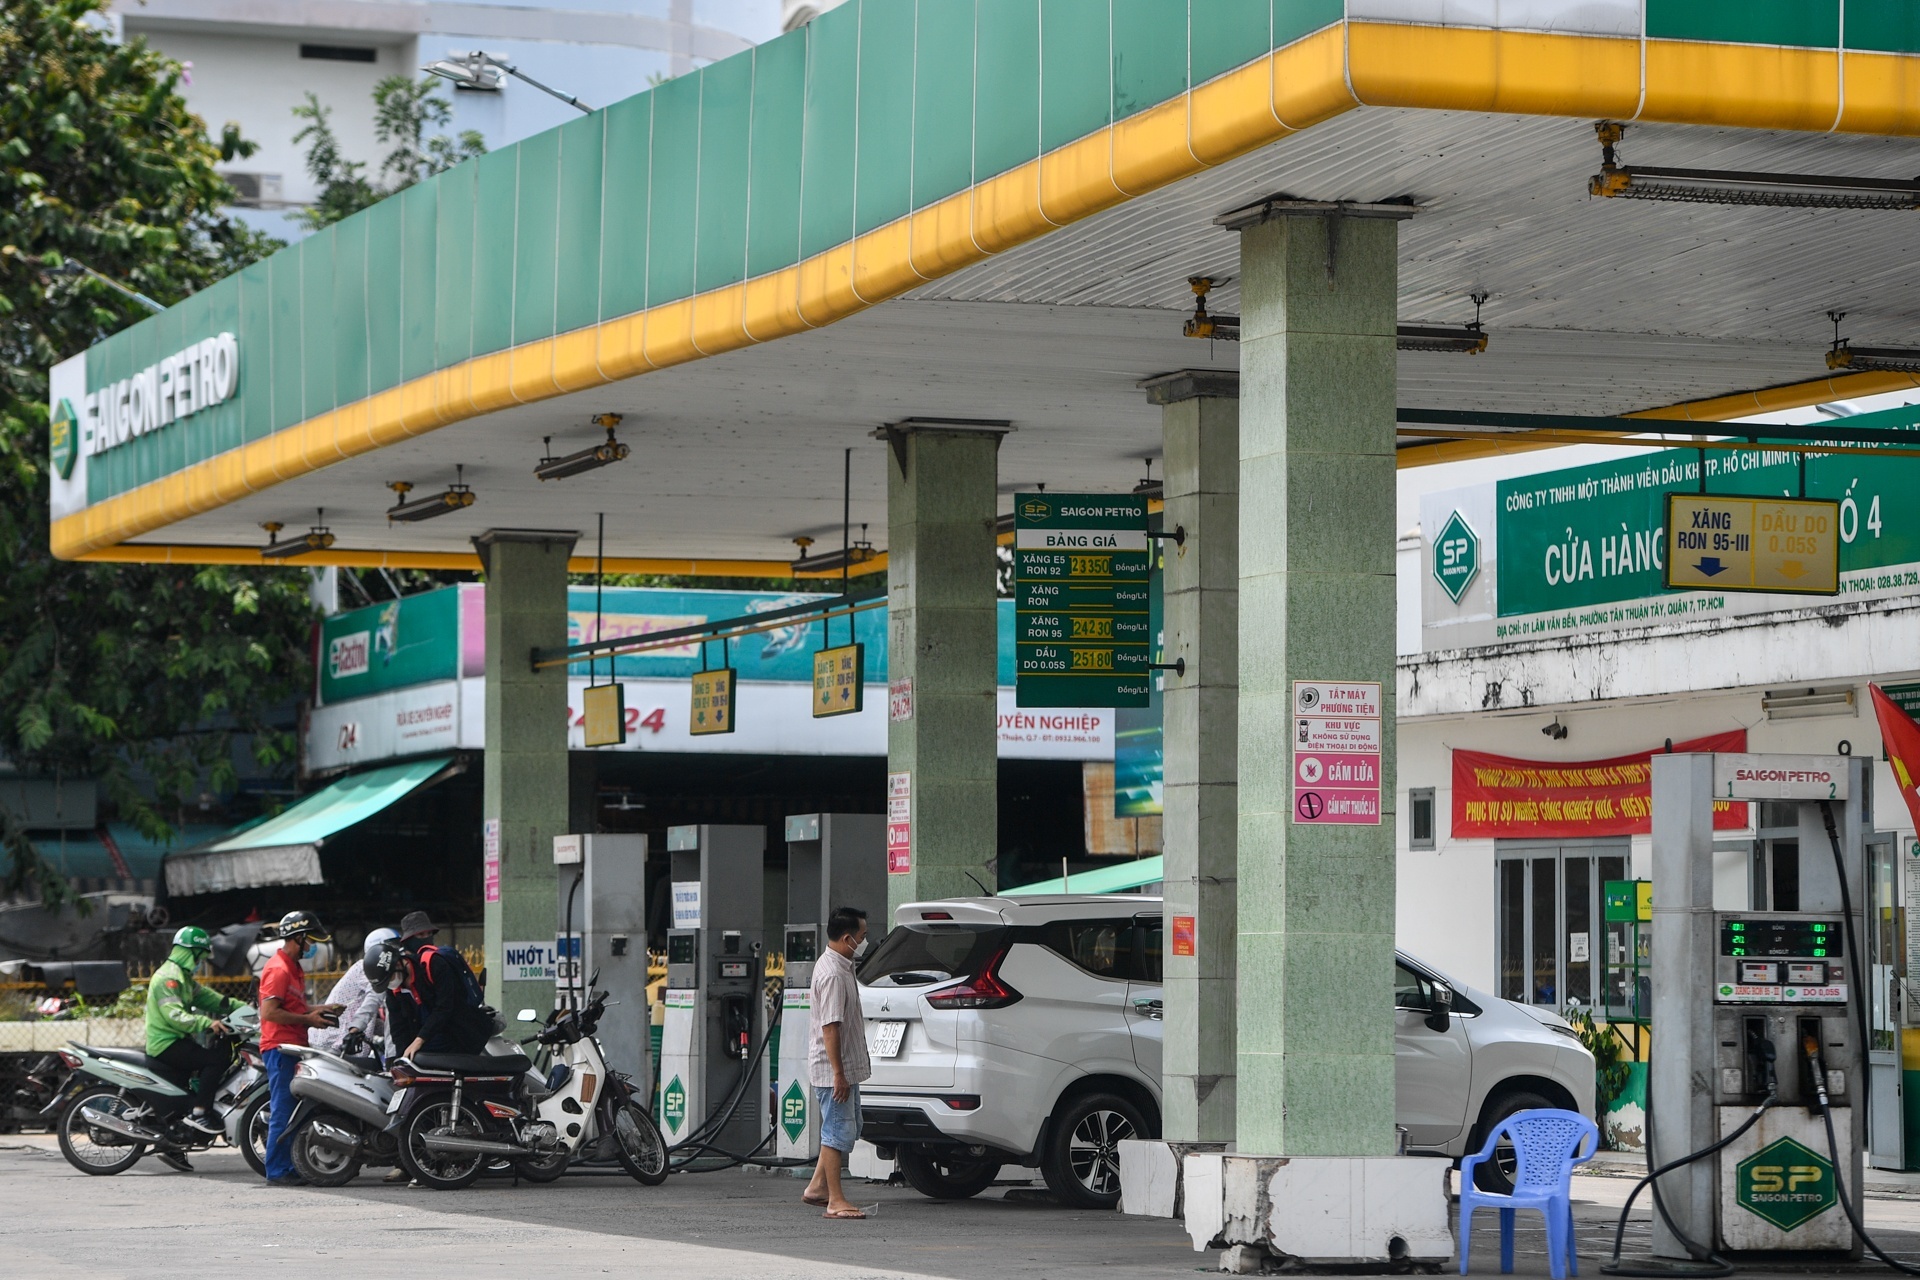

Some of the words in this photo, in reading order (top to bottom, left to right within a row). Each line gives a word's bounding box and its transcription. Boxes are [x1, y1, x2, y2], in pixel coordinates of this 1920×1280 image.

[84, 364, 161, 457] SAIGON
[160, 331, 238, 428] PETRO
[1506, 491, 1533, 512] CÔNG
[1535, 491, 1547, 507] TY
[1549, 485, 1576, 504] TNHH
[1578, 478, 1599, 501] MỘT
[1601, 472, 1634, 495] THÀNH
[1637, 467, 1659, 489] VIÊN
[1662, 459, 1683, 485] DẦU
[1685, 463, 1700, 480] KH
[1705, 460, 1721, 477] TP.
[1723, 449, 1739, 474] HỒ
[1762, 451, 1790, 467] MINH
[1025, 504, 1047, 513] SP
[1061, 507, 1103, 517] SAIGON
[1105, 507, 1142, 517] PETRO
[1840, 478, 1858, 544] Ố
[1867, 495, 1882, 539] 4
[1692, 508, 1731, 530] XĂNG
[1762, 508, 1798, 533] DẦU
[1804, 515, 1827, 534] DO
[1046, 532, 1088, 547] BẢNG
[1093, 533, 1117, 547] GIÁ
[1678, 531, 1707, 550] RON
[1713, 534, 1749, 552] 95-III
[1769, 535, 1817, 555] 0.05S
[1023, 554, 1050, 564] XĂNG
[1053, 555, 1065, 564] E5
[1443, 538, 1468, 566] SP
[1545, 527, 1594, 586] CỬA
[1601, 522, 1663, 578] HÀNG
[1026, 566, 1048, 575] RON
[1050, 566, 1061, 576] 92
[1072, 557, 1109, 574] 23350
[1116, 563, 1146, 572] Đồng/Lít
[1031, 585, 1059, 595] XĂNG
[1849, 577, 1875, 593] THOẠI:
[1028, 597, 1049, 606] RON
[1116, 591, 1147, 600] Đồng/Lít
[1031, 616, 1059, 626] XĂNG
[1497, 624, 1507, 639] ĐỊA
[1523, 623, 1530, 634] 01
[1532, 618, 1545, 633] LÂM
[1547, 616, 1561, 631] VĂN
[1580, 610, 1608, 626] PHƯỜNG
[1610, 607, 1624, 622] TÂN
[1625, 604, 1648, 621] THUẬN
[1650, 602, 1666, 618] TÂY,
[1668, 599, 1688, 616] QUẬN
[1690, 601, 1696, 614] 7,
[1697, 597, 1725, 611] TP.HCM
[1028, 628, 1049, 637] RON
[1051, 629, 1062, 638] 95
[1074, 620, 1111, 636] 24230
[1036, 647, 1057, 658] DẦU
[1075, 651, 1111, 668] 25180
[1117, 654, 1148, 663] Đồng/Lít
[1024, 661, 1038, 669] DO
[1040, 661, 1066, 670] 0.05S
[1117, 686, 1148, 695] Đồng/Lít
[1347, 688, 1366, 700] MÁY
[1321, 703, 1353, 714] PHƯƠNG
[1356, 702, 1374, 715] TIỆN
[997, 711, 1035, 729] UYÊN
[1040, 713, 1100, 734] NGHIỆP
[1325, 721, 1341, 729] KHU
[1344, 722, 1360, 731] VỰC
[1313, 732, 1337, 740] KHÔNG
[1308, 741, 1324, 750] ĐIỆN
[1327, 743, 1348, 751] THOẠI
[1358, 743, 1377, 752] ĐỘNG
[1328, 761, 1351, 781] CẤM
[1354, 760, 1373, 781] LỬA
[1737, 770, 1787, 782] SAIGON
[1788, 771, 1831, 783] PETRO
[1728, 781, 1733, 797] 1
[1829, 782, 1836, 798] 2
[1328, 795, 1340, 815] CẤM
[1351, 795, 1369, 815] THUỐC
[1466, 801, 1486, 826] PHỤC
[1488, 801, 1499, 826] VỤ
[1513, 796, 1539, 826] NGHIỆP
[1539, 796, 1563, 821] CÔNG
[1563, 796, 1593, 825] NGHIỆP
[1595, 795, 1616, 820] HÓA
[1620, 793, 1646, 822] HIỆN
[507, 945, 544, 965] NHỚT
[883, 1023, 899, 1038] 51G
[667, 1093, 683, 1110] SP
[785, 1099, 803, 1117] SP
[1751, 1165, 1823, 1192] SP
[1751, 1193, 1788, 1202] SAIGON
[1790, 1193, 1823, 1202] PETRO
